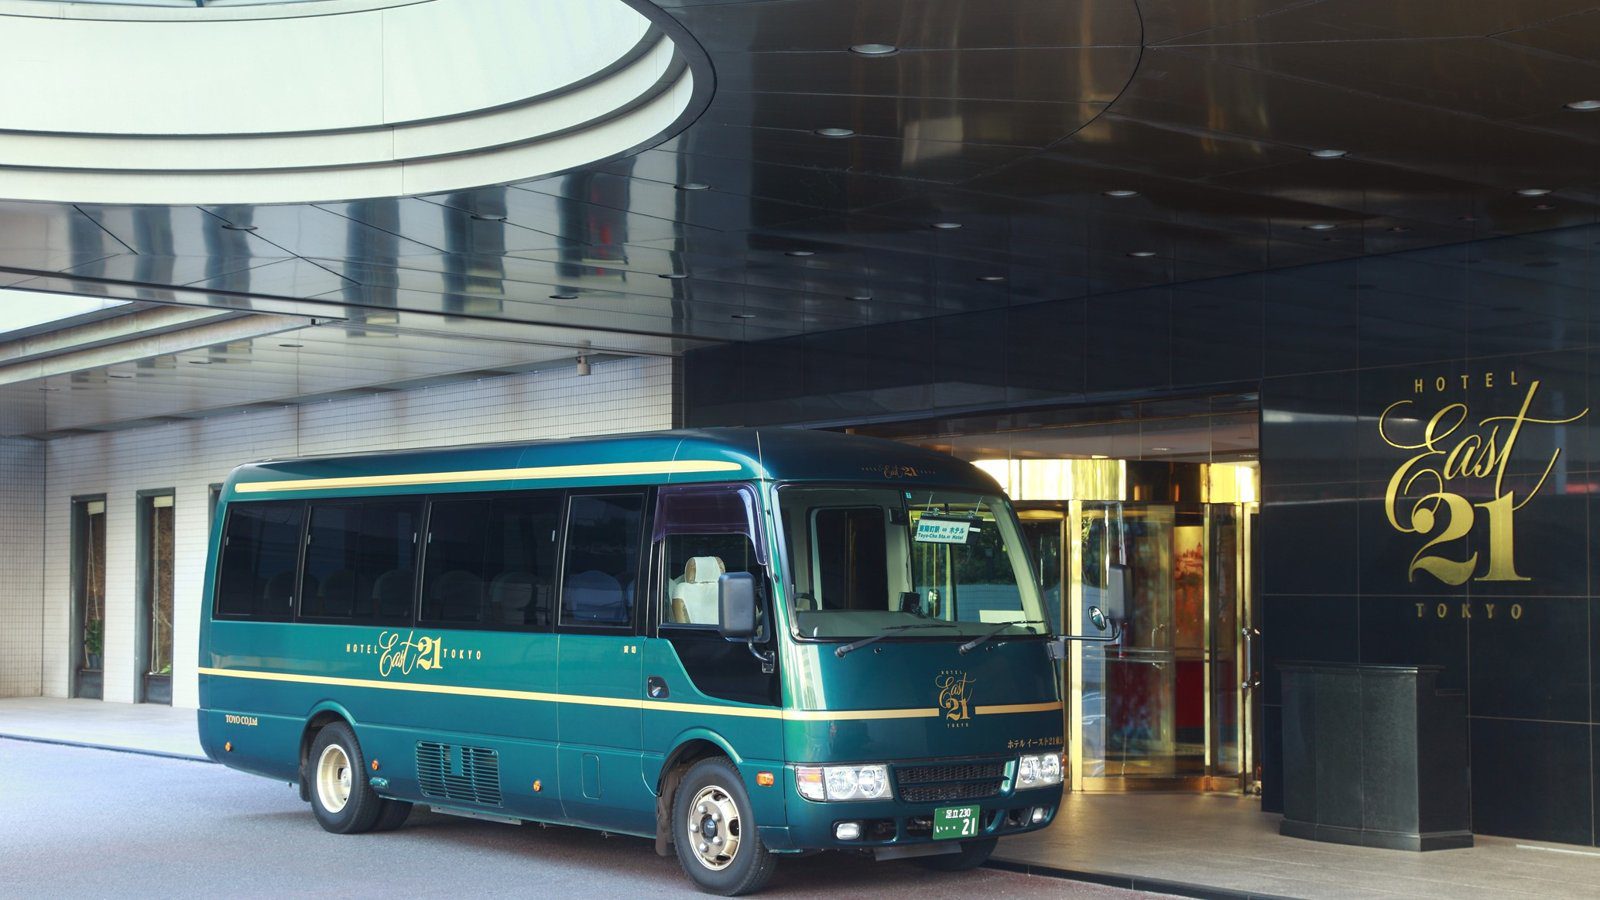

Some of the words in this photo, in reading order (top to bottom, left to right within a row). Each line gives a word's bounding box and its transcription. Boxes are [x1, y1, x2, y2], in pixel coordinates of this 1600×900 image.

[1414, 371, 1518, 393] HOTEL
[1379, 380, 1589, 533] East
[1408, 490, 1532, 586] 21
[1415, 603, 1522, 620] TOKYO
[346, 643, 378, 655] HOTEL
[379, 630, 418, 677] East
[416, 636, 443, 670] 21
[443, 648, 482, 660] TOKYO
[935, 672, 977, 709] East
[225, 714, 241, 724] TOYO
[946, 697, 971, 721] 21
[945, 809, 958, 819] 足立
[959, 808, 971, 818] 230
[961, 817, 976, 835] 21
